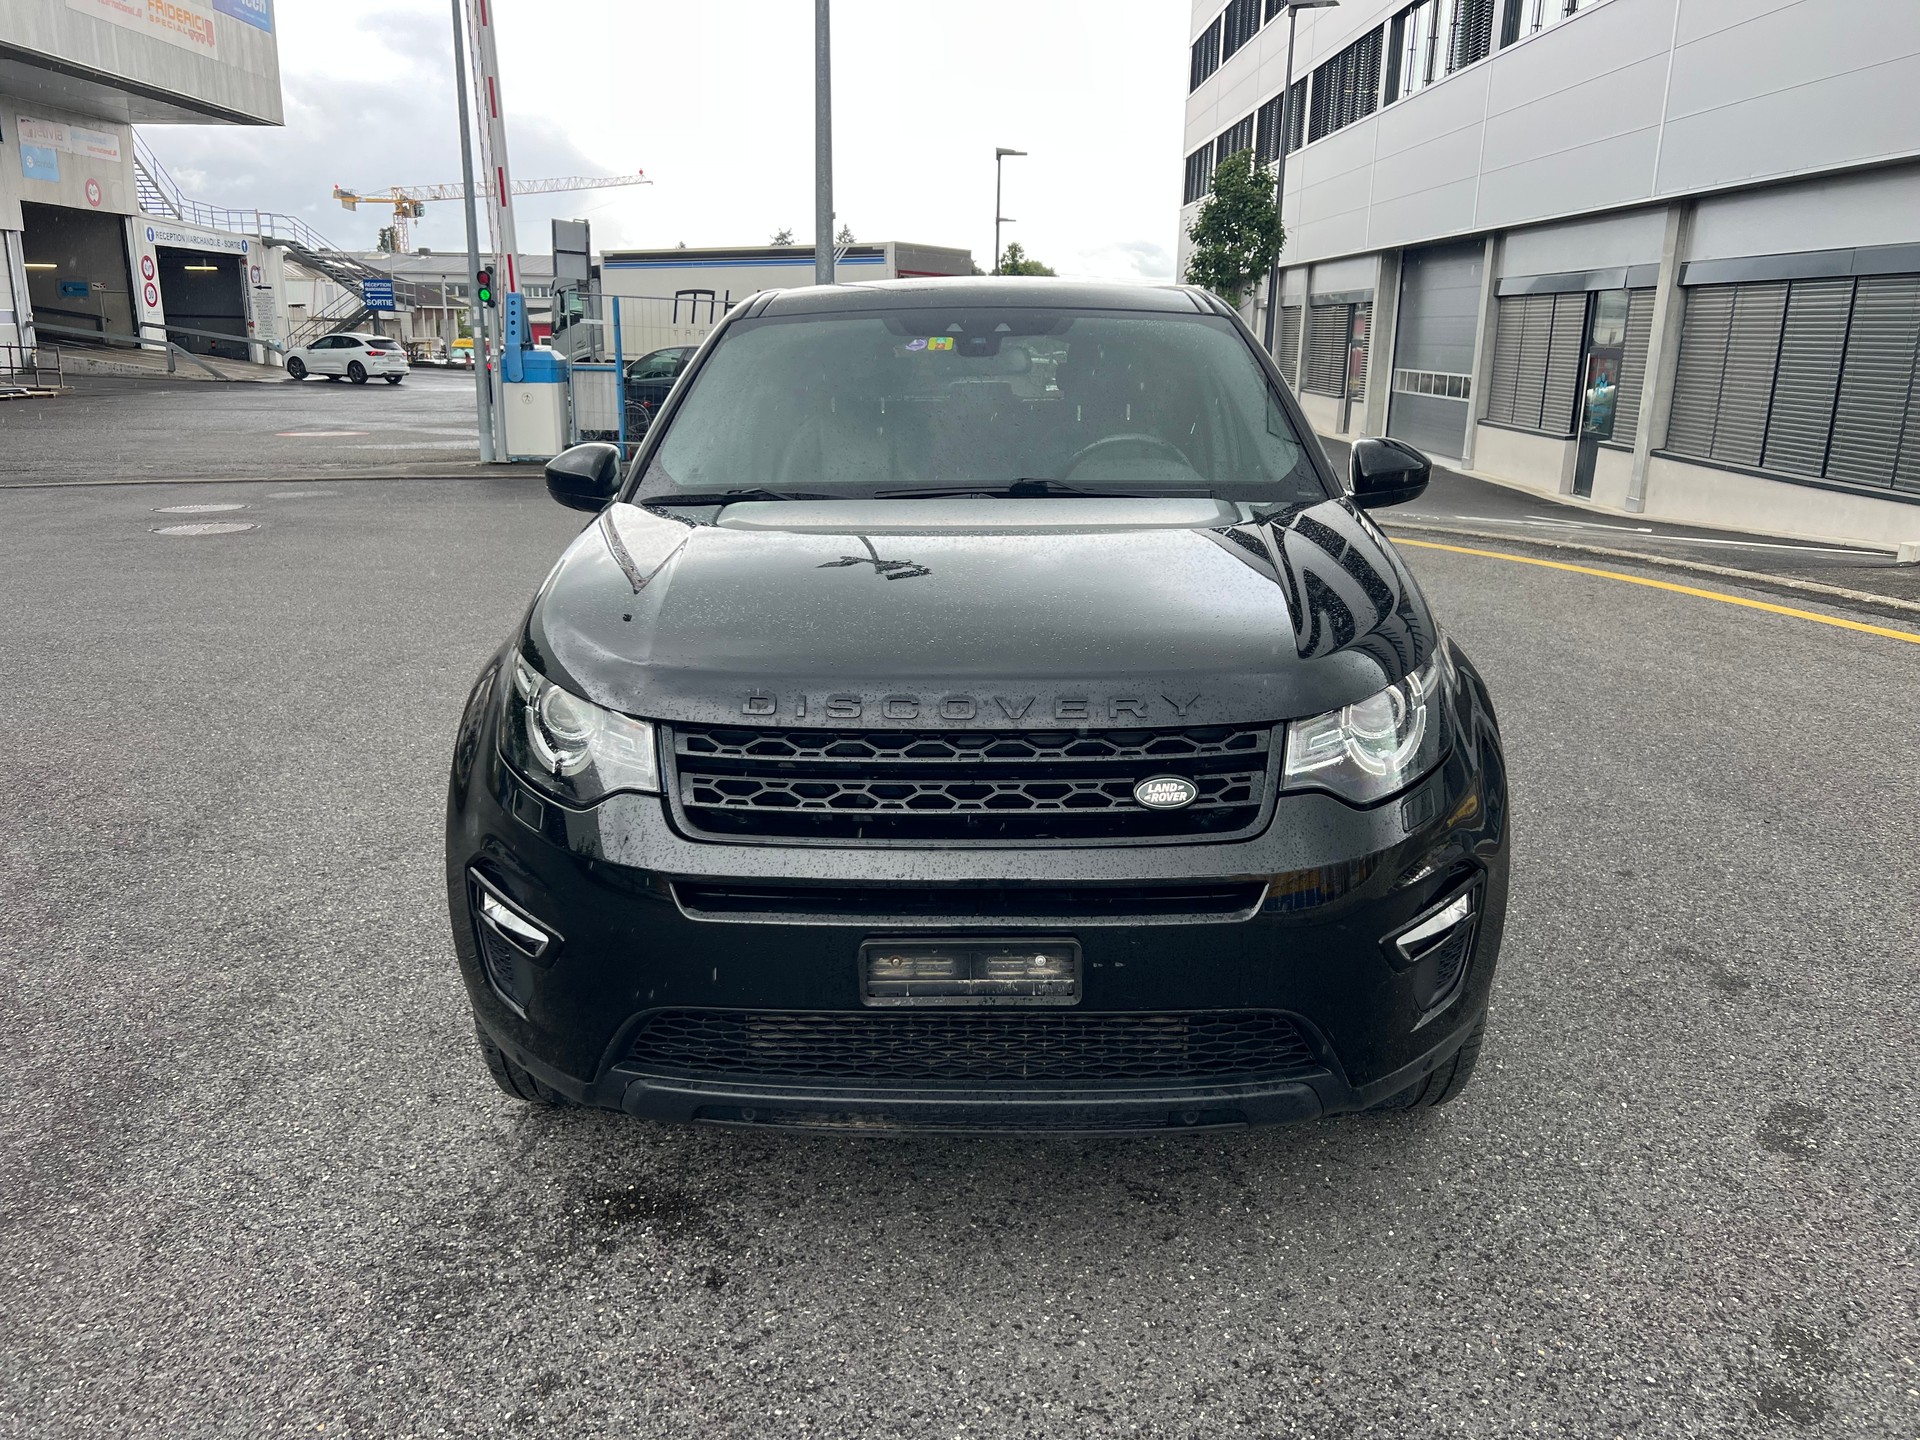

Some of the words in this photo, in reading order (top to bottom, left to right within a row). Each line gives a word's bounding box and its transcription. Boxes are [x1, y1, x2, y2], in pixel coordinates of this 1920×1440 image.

[147, 0, 206, 32] FRIDERICI
[149, 14, 188, 35] SPECIAL
[224, 239, 241, 250] SORTIE
[366, 298, 394, 306] SORTIE
[742, 694, 1201, 720] DISCOVERY
[1147, 782, 1178, 793] LAND
[1150, 791, 1188, 802] ROVER
